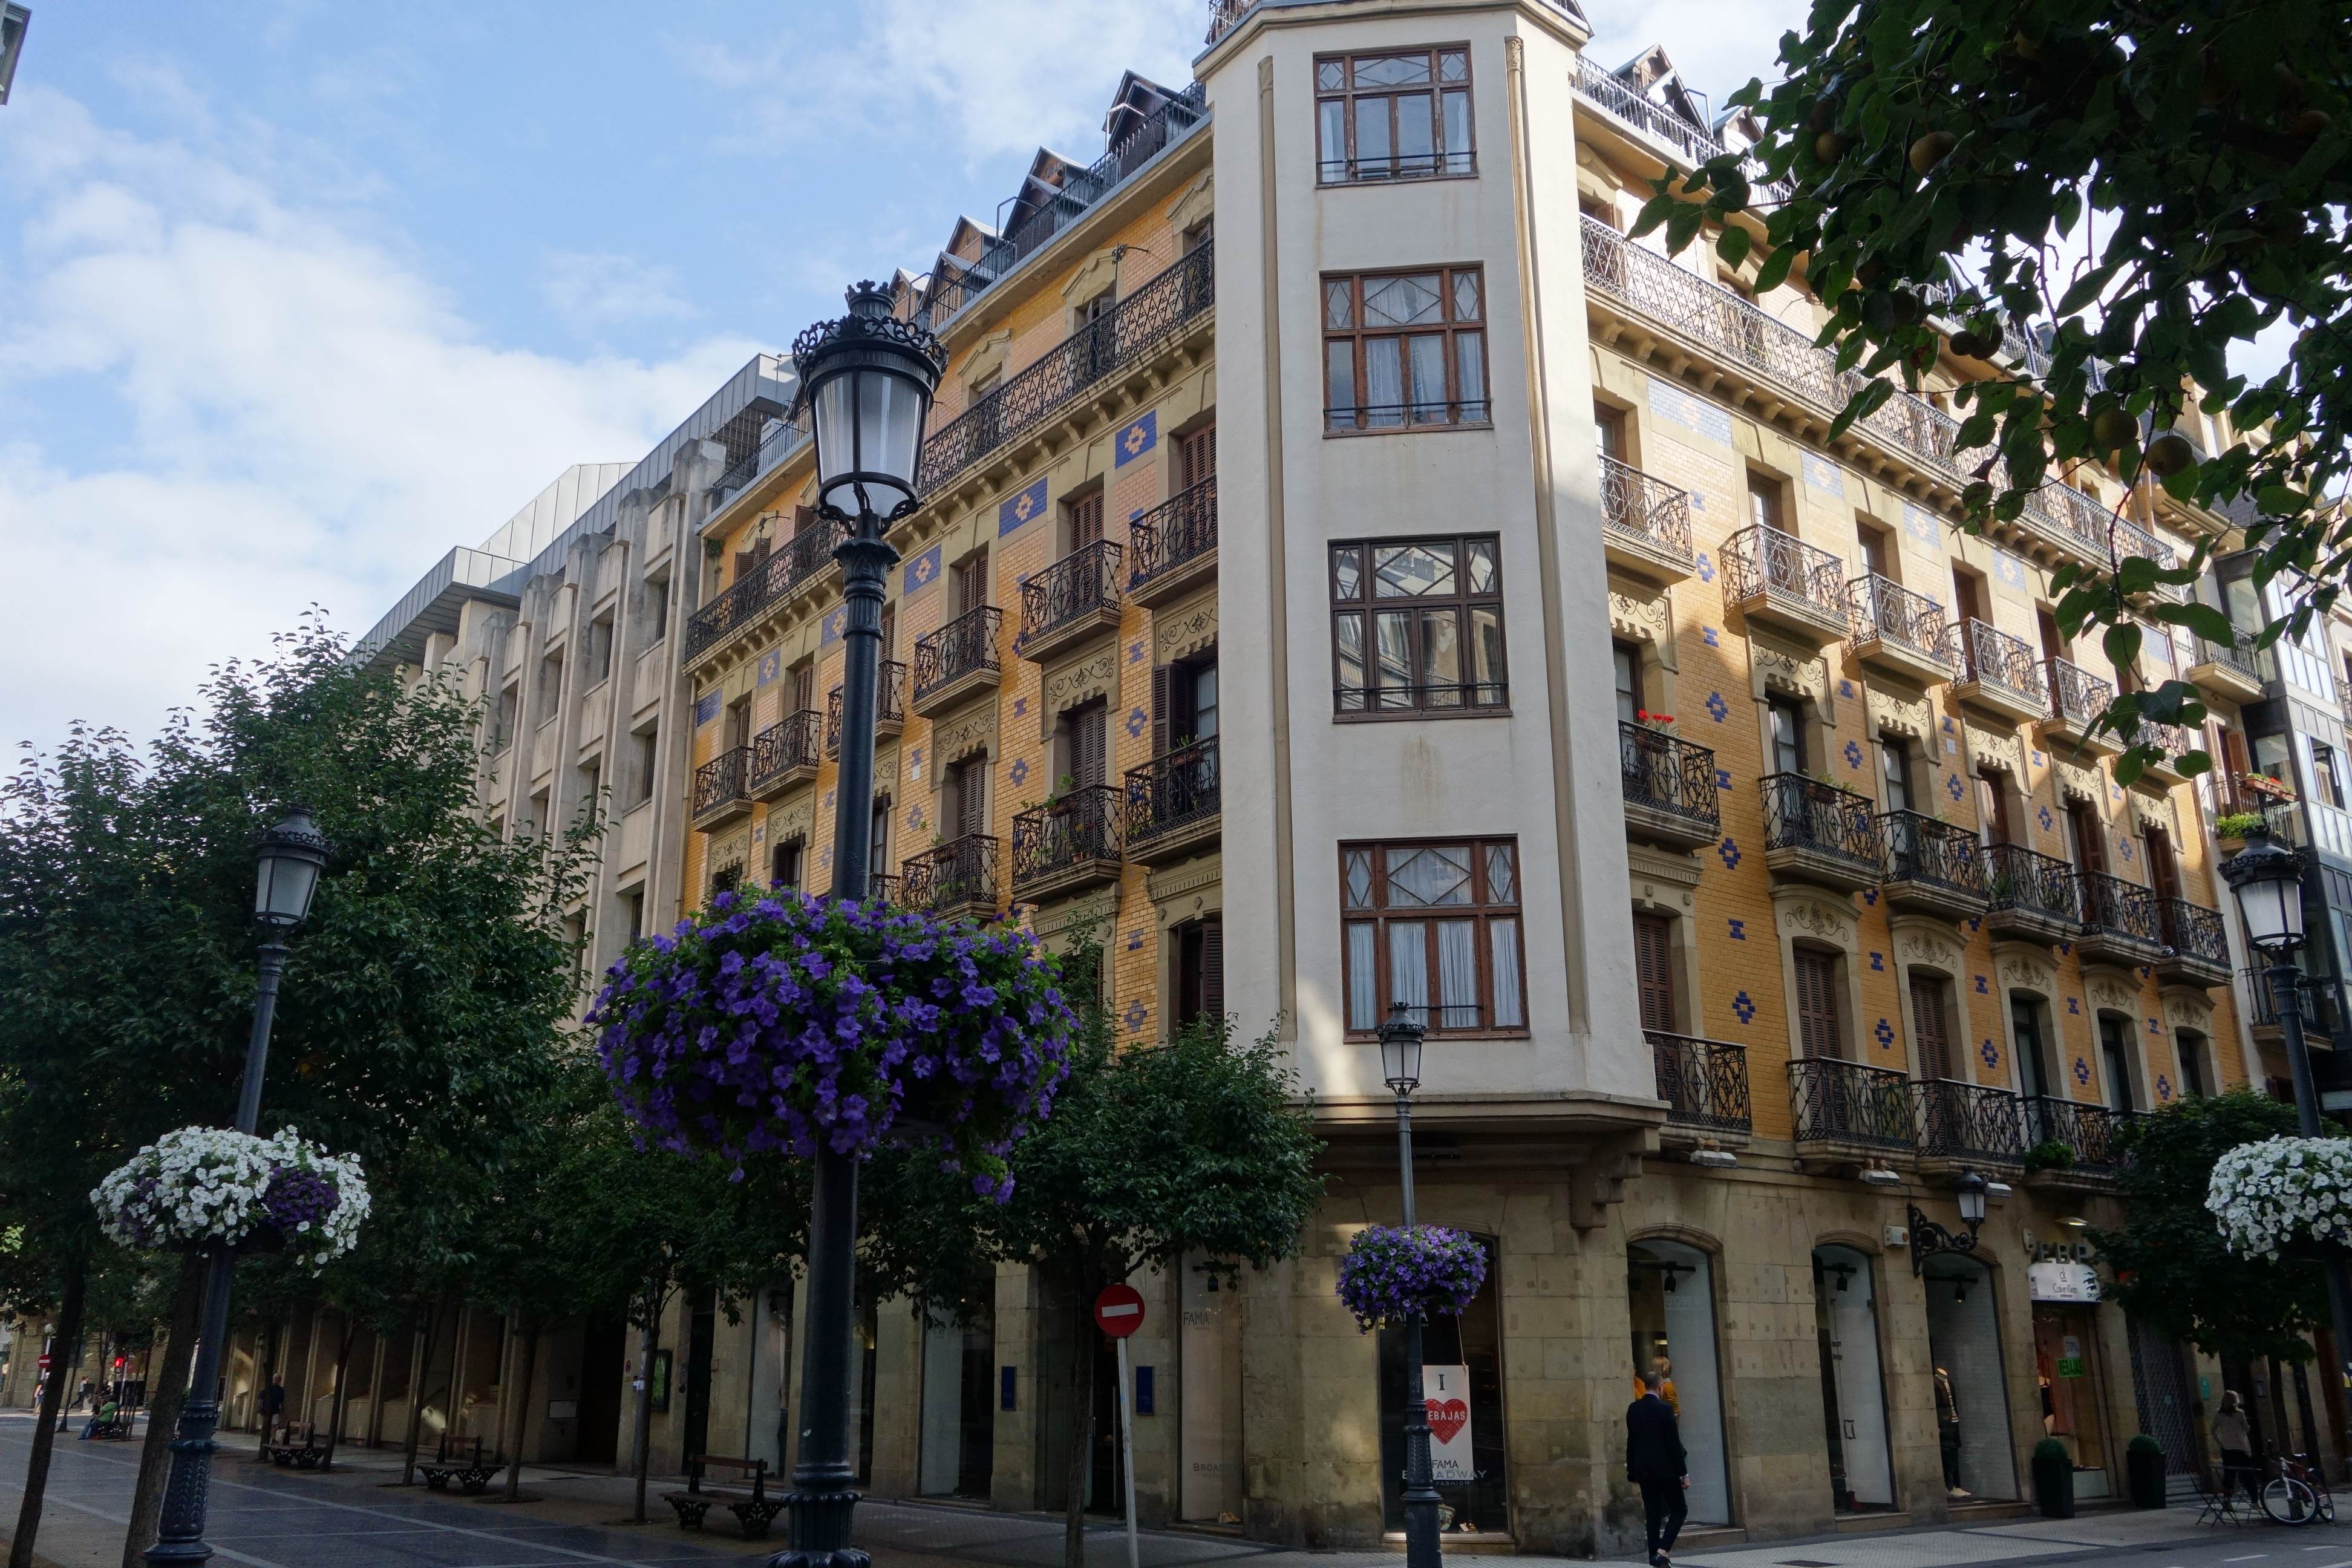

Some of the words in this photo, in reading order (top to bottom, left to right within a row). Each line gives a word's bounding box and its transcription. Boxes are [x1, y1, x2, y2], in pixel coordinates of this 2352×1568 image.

[1183, 1312, 1210, 1325] FAMA
[1439, 1374, 1445, 1391] I
[1428, 1411, 1467, 1420] EBAJAS
[1432, 1460, 1459, 1469] FAMA
